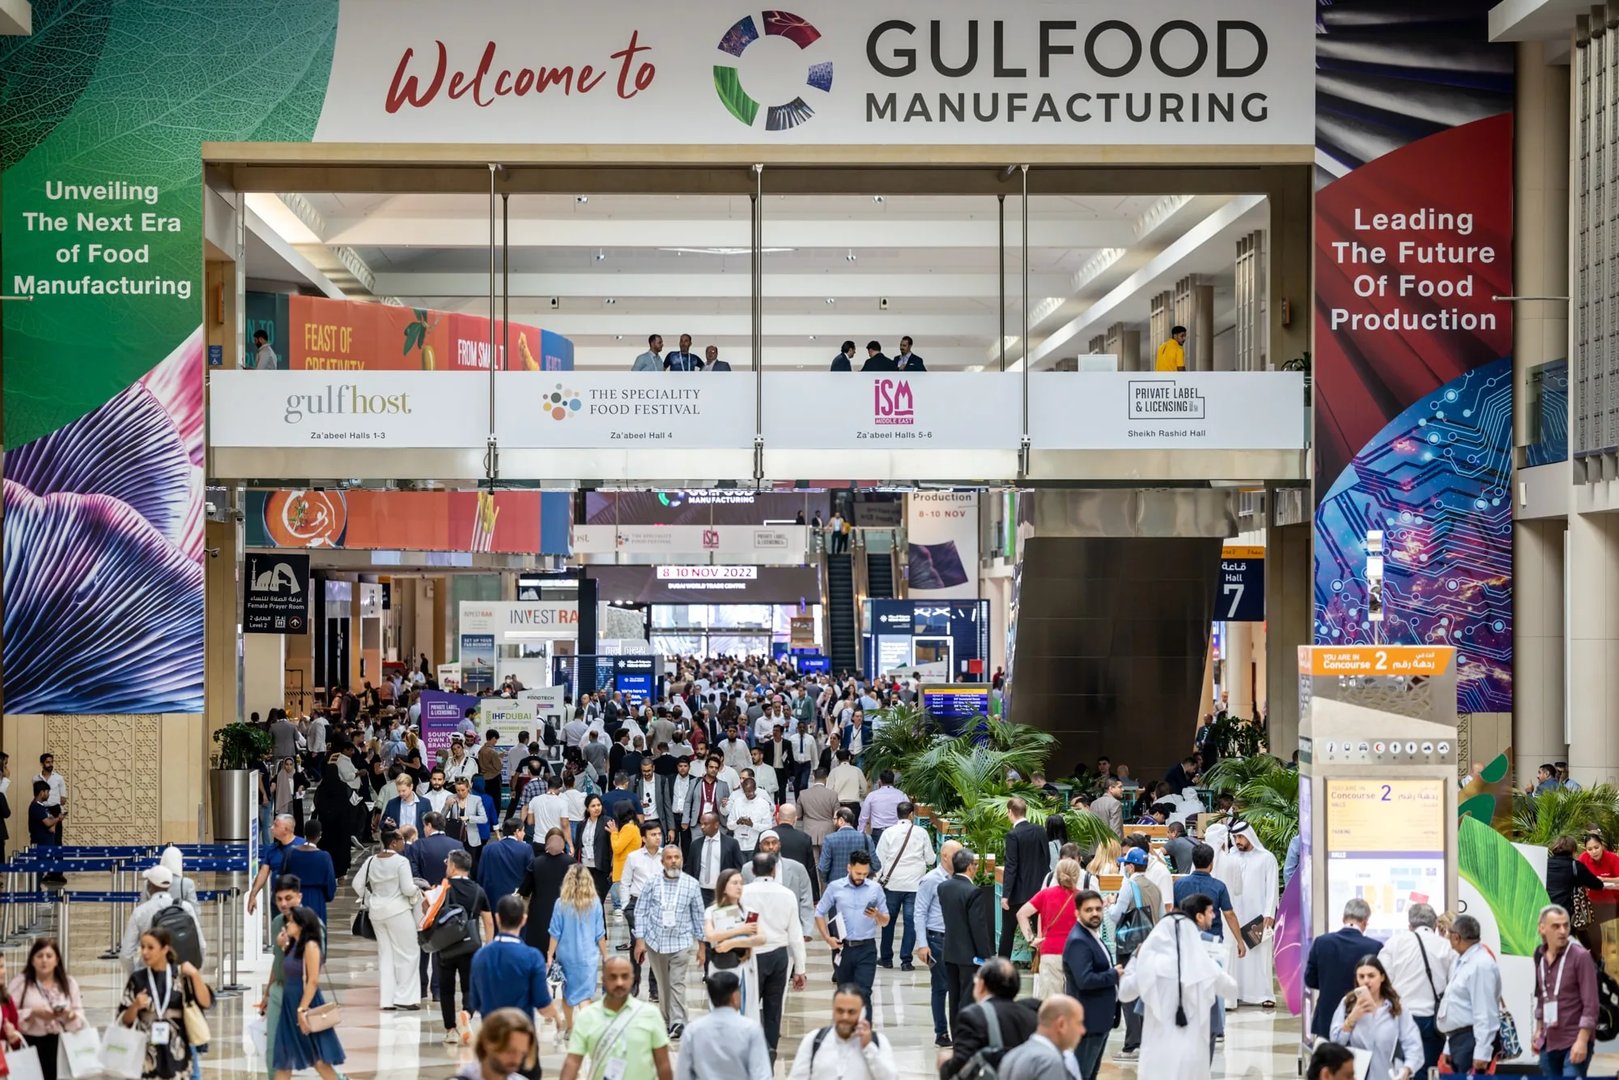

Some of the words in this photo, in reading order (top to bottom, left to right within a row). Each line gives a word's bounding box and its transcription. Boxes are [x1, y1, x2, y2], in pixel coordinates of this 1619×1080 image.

[866, 19, 1268, 78] GULFOOD
[384, 40, 605, 114] Welcome
[611, 30, 656, 99] to
[866, 92, 1268, 124] MANUFACTURING
[45, 180, 159, 204] Unveiling
[22, 212, 68, 231] The
[76, 212, 134, 231] Next
[141, 212, 182, 231] Era
[1354, 208, 1473, 235] Leading
[56, 243, 83, 263] of
[89, 244, 149, 263] Food
[1331, 242, 1386, 264] The
[1399, 242, 1496, 264] Future
[13, 275, 192, 300] Manufacturing
[1353, 275, 1388, 297] Of
[1399, 275, 1473, 297] Food
[1331, 308, 1496, 331] Production
[305, 323, 337, 352] FEAST
[340, 326, 353, 353] OF
[458, 339, 478, 367] FROM
[589, 389, 618, 400] THE
[621, 389, 701, 400] SPECIALITY
[1135, 387, 1170, 399] PRIVATE
[1173, 387, 1199, 399] LABEL
[283, 384, 412, 425] gulfhost
[590, 404, 630, 415] FOOD
[634, 404, 701, 415] FESTIVAL
[1135, 401, 1143, 412] &
[1145, 401, 1188, 412] LICENSING
[310, 431, 347, 440] Za'abeel
[349, 431, 371, 440] Halls
[373, 431, 386, 440] 1-3
[610, 431, 646, 440] Za'abeel
[649, 431, 665, 439] Hall
[667, 431, 673, 439] 4
[856, 431, 892, 439] Za'abeel
[895, 431, 916, 439] Halls
[918, 431, 933, 439] 5-6
[1128, 429, 1156, 437] Sheikh
[1159, 429, 1187, 437] Rashid
[1190, 429, 1206, 437] Hall
[688, 496, 755, 504] MANUFACTURING
[913, 493, 972, 502] Production
[662, 568, 670, 577] 8
[676, 568, 689, 577] 10
[691, 568, 719, 577] NOV
[723, 568, 752, 577] 2022
[1221, 561, 1247, 571] قاعة
[1225, 573, 1243, 582] Hall
[269, 603, 287, 611] Prayer
[1223, 583, 1245, 618] 7
[510, 609, 556, 624] INVEST
[1323, 661, 1371, 670] Concourse
[1375, 651, 1388, 671] 2
[1393, 660, 1411, 670] رقم
[1331, 792, 1376, 800] Concourse
[1381, 784, 1392, 801] 2
